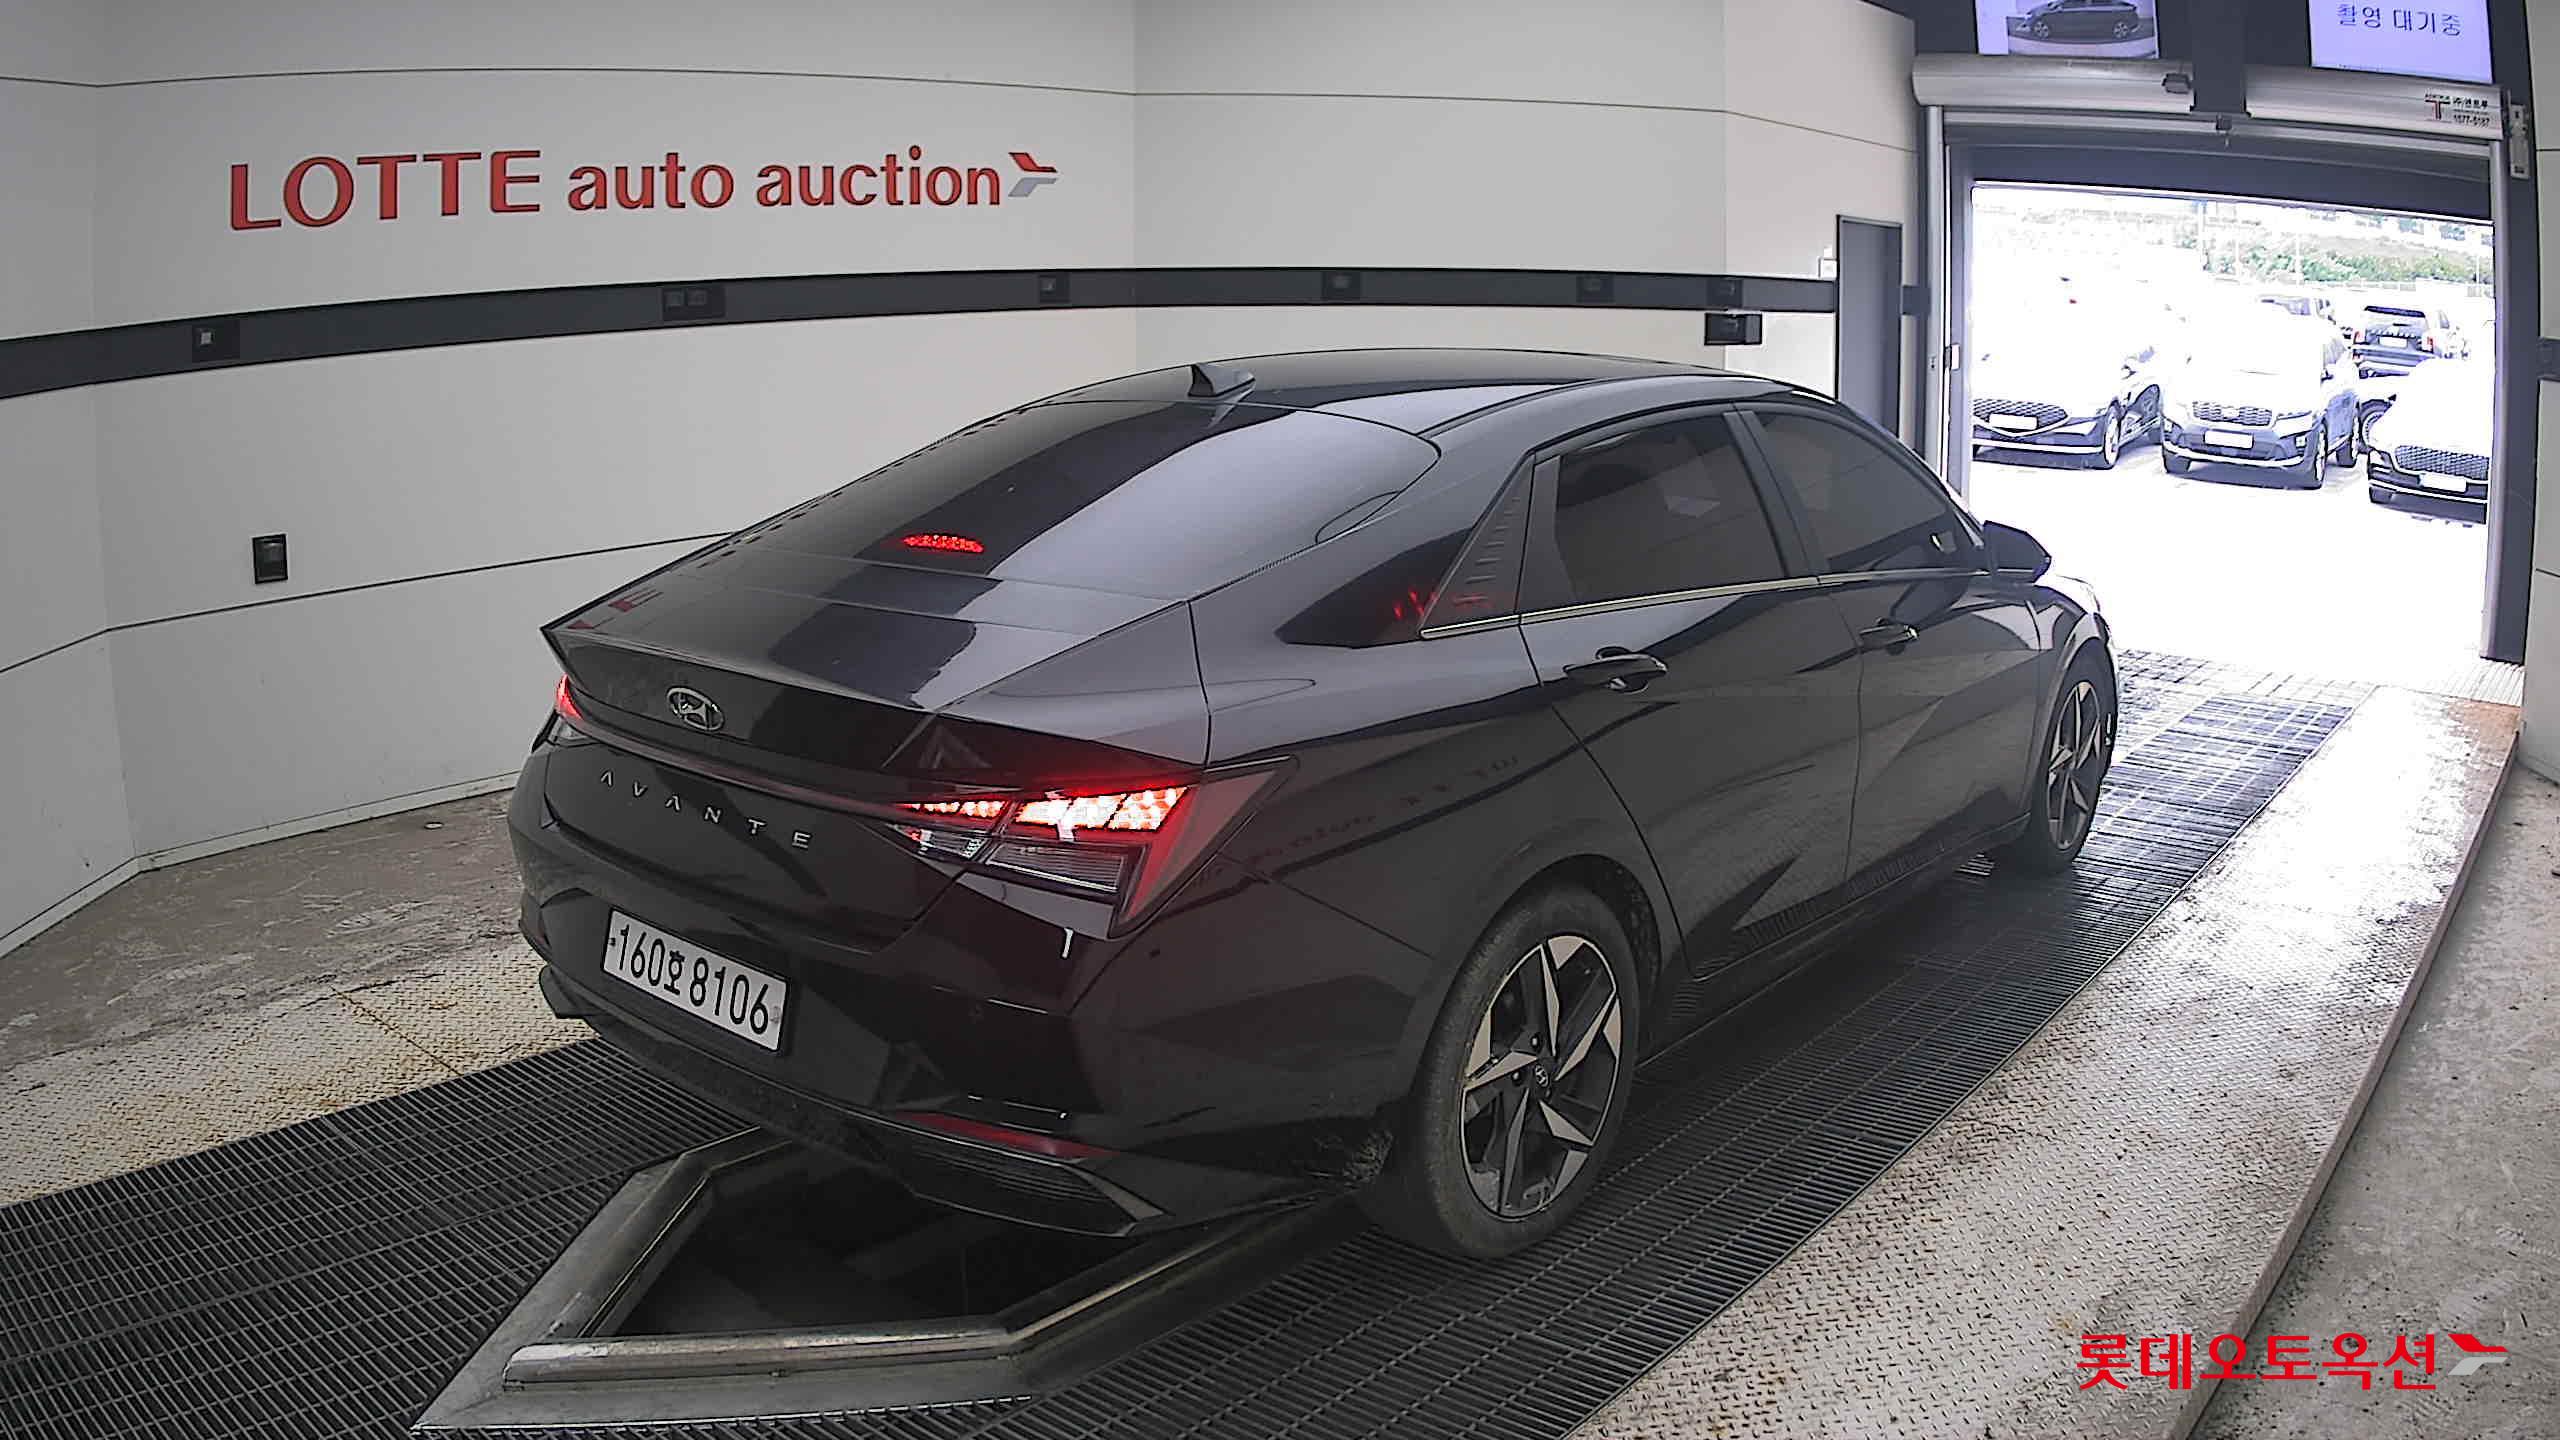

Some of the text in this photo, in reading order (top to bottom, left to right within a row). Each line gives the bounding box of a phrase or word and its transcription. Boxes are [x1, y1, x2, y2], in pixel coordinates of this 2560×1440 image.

[2393, 9, 2461, 37] 대기중
[229, 145, 1003, 232] LOTTE auto auction
[600, 770, 811, 849] AVANTE
